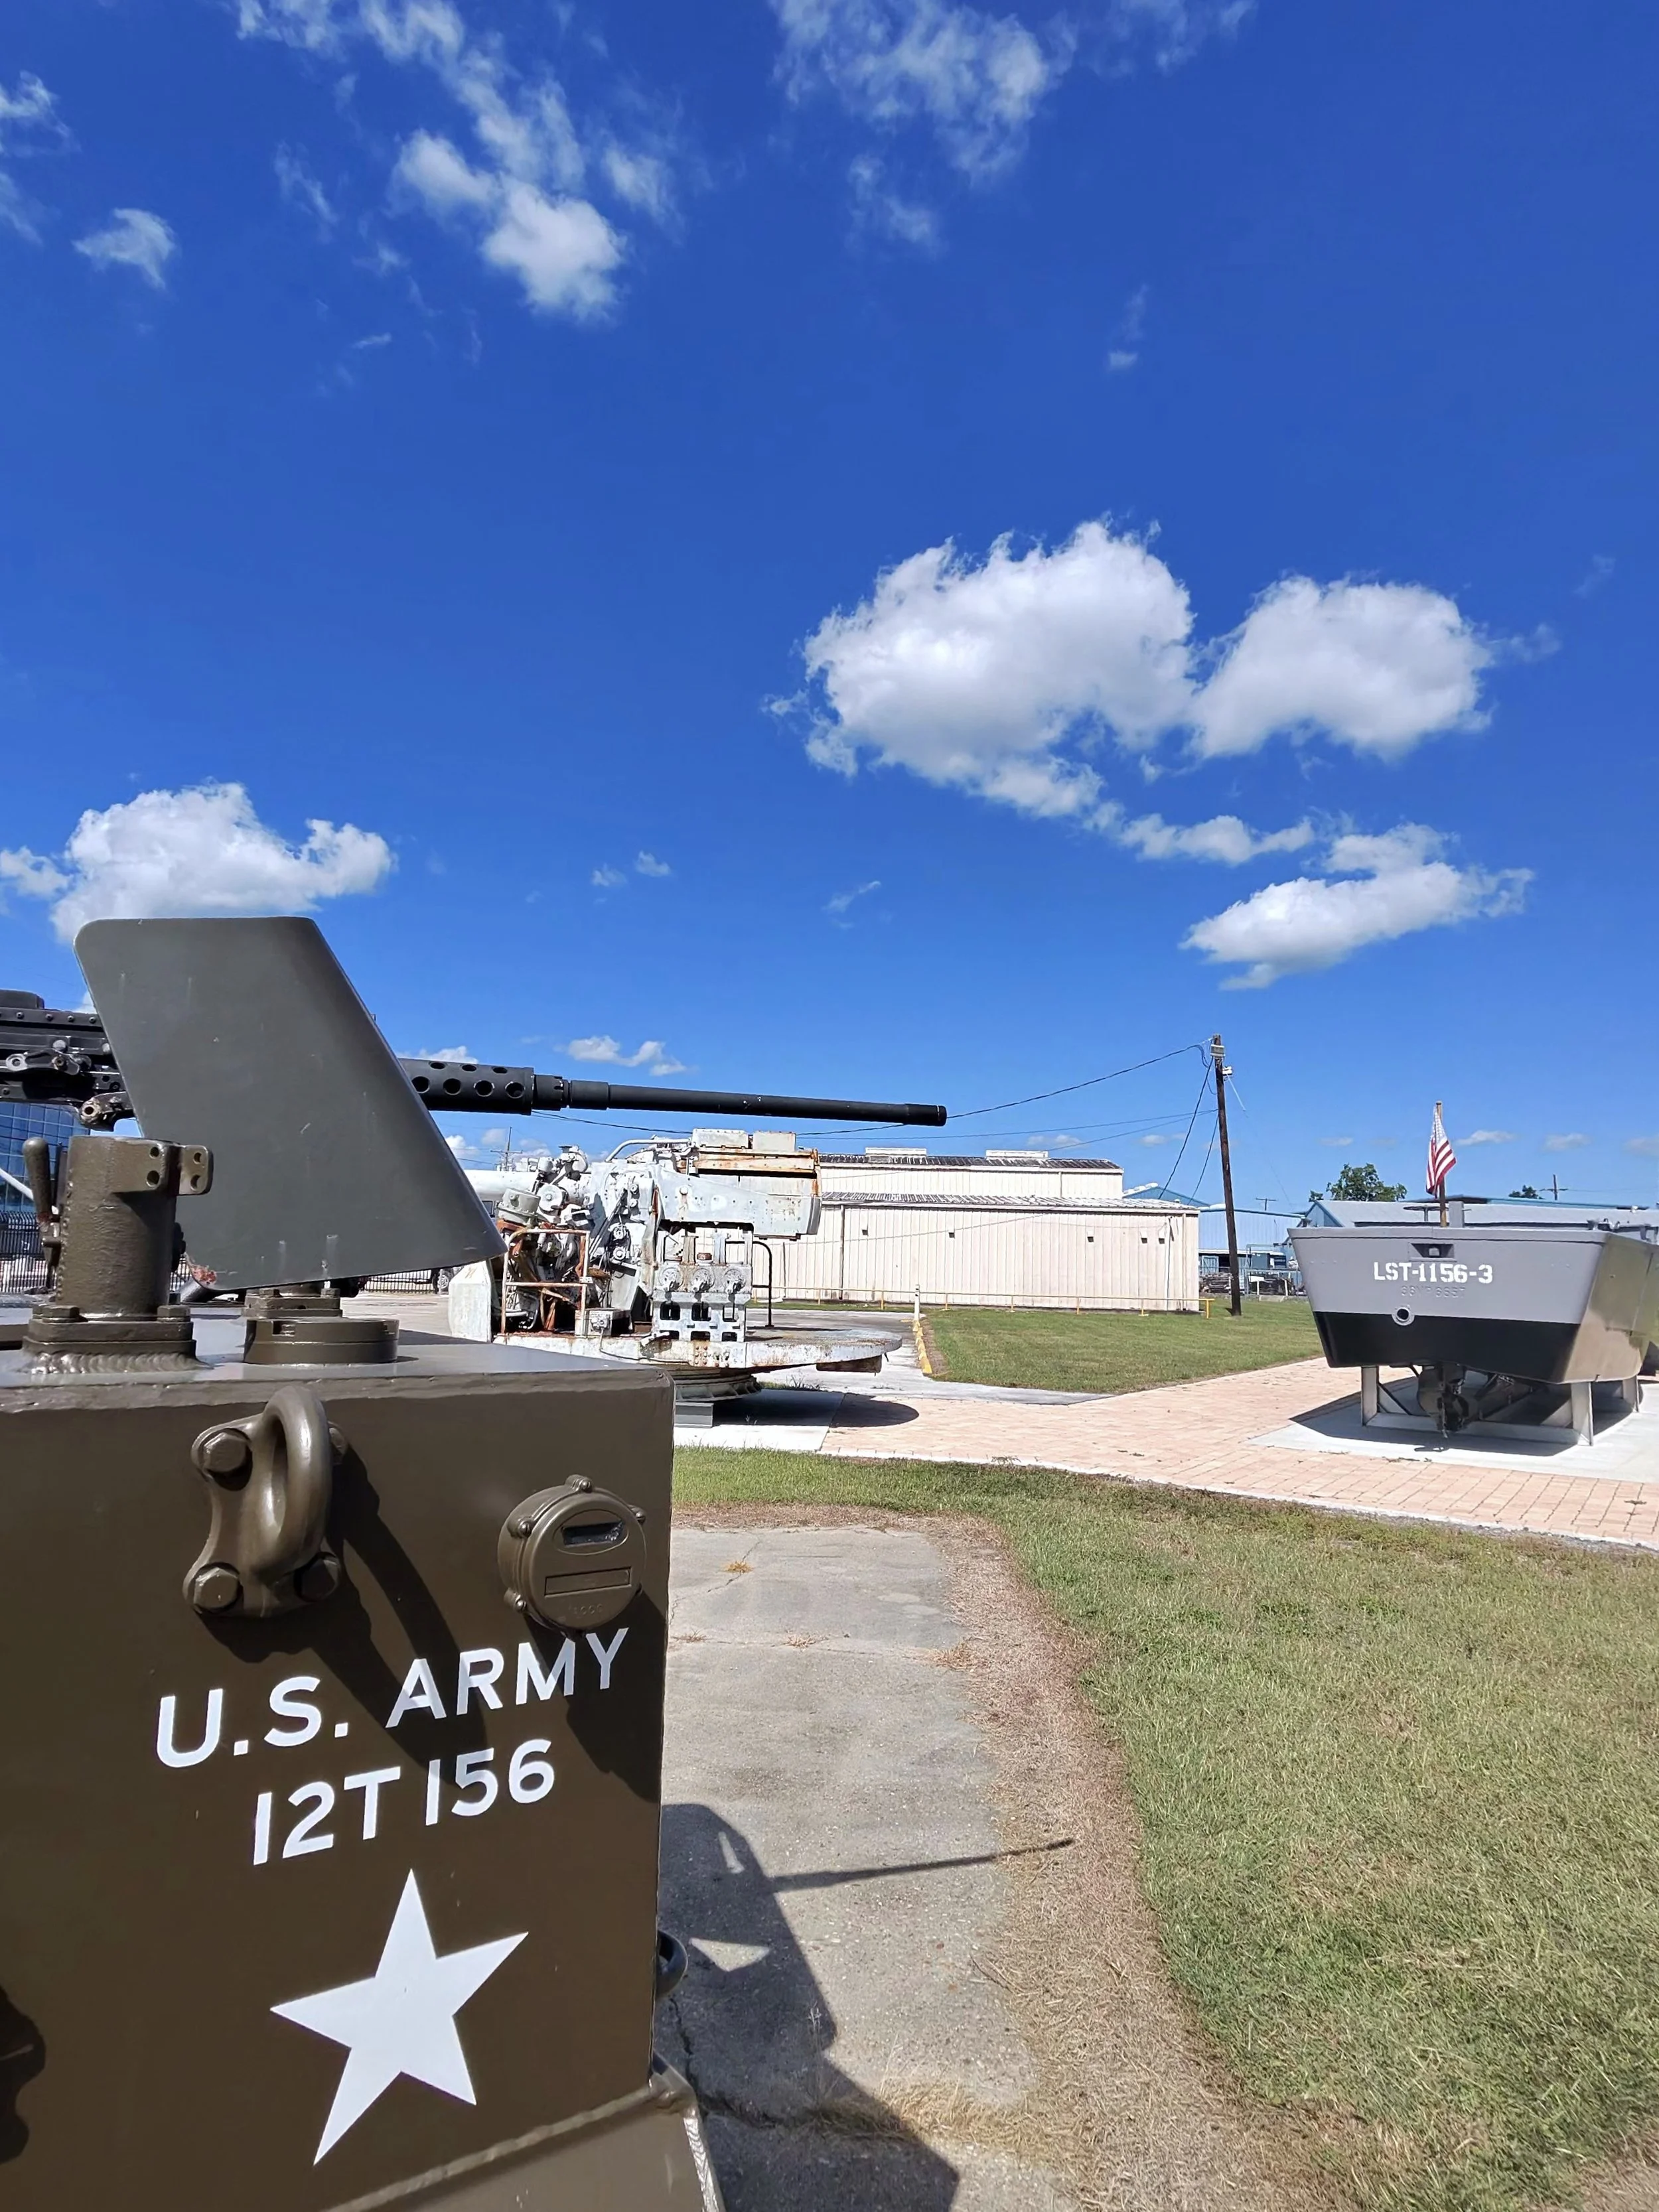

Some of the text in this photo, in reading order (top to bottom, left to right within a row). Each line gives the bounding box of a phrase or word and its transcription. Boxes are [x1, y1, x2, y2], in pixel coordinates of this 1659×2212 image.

[1373, 1261, 1494, 1284] LST-1156-3
[156, 1627, 629, 1768] U.S. ARMY
[253, 1738, 555, 1866] 12T 156
